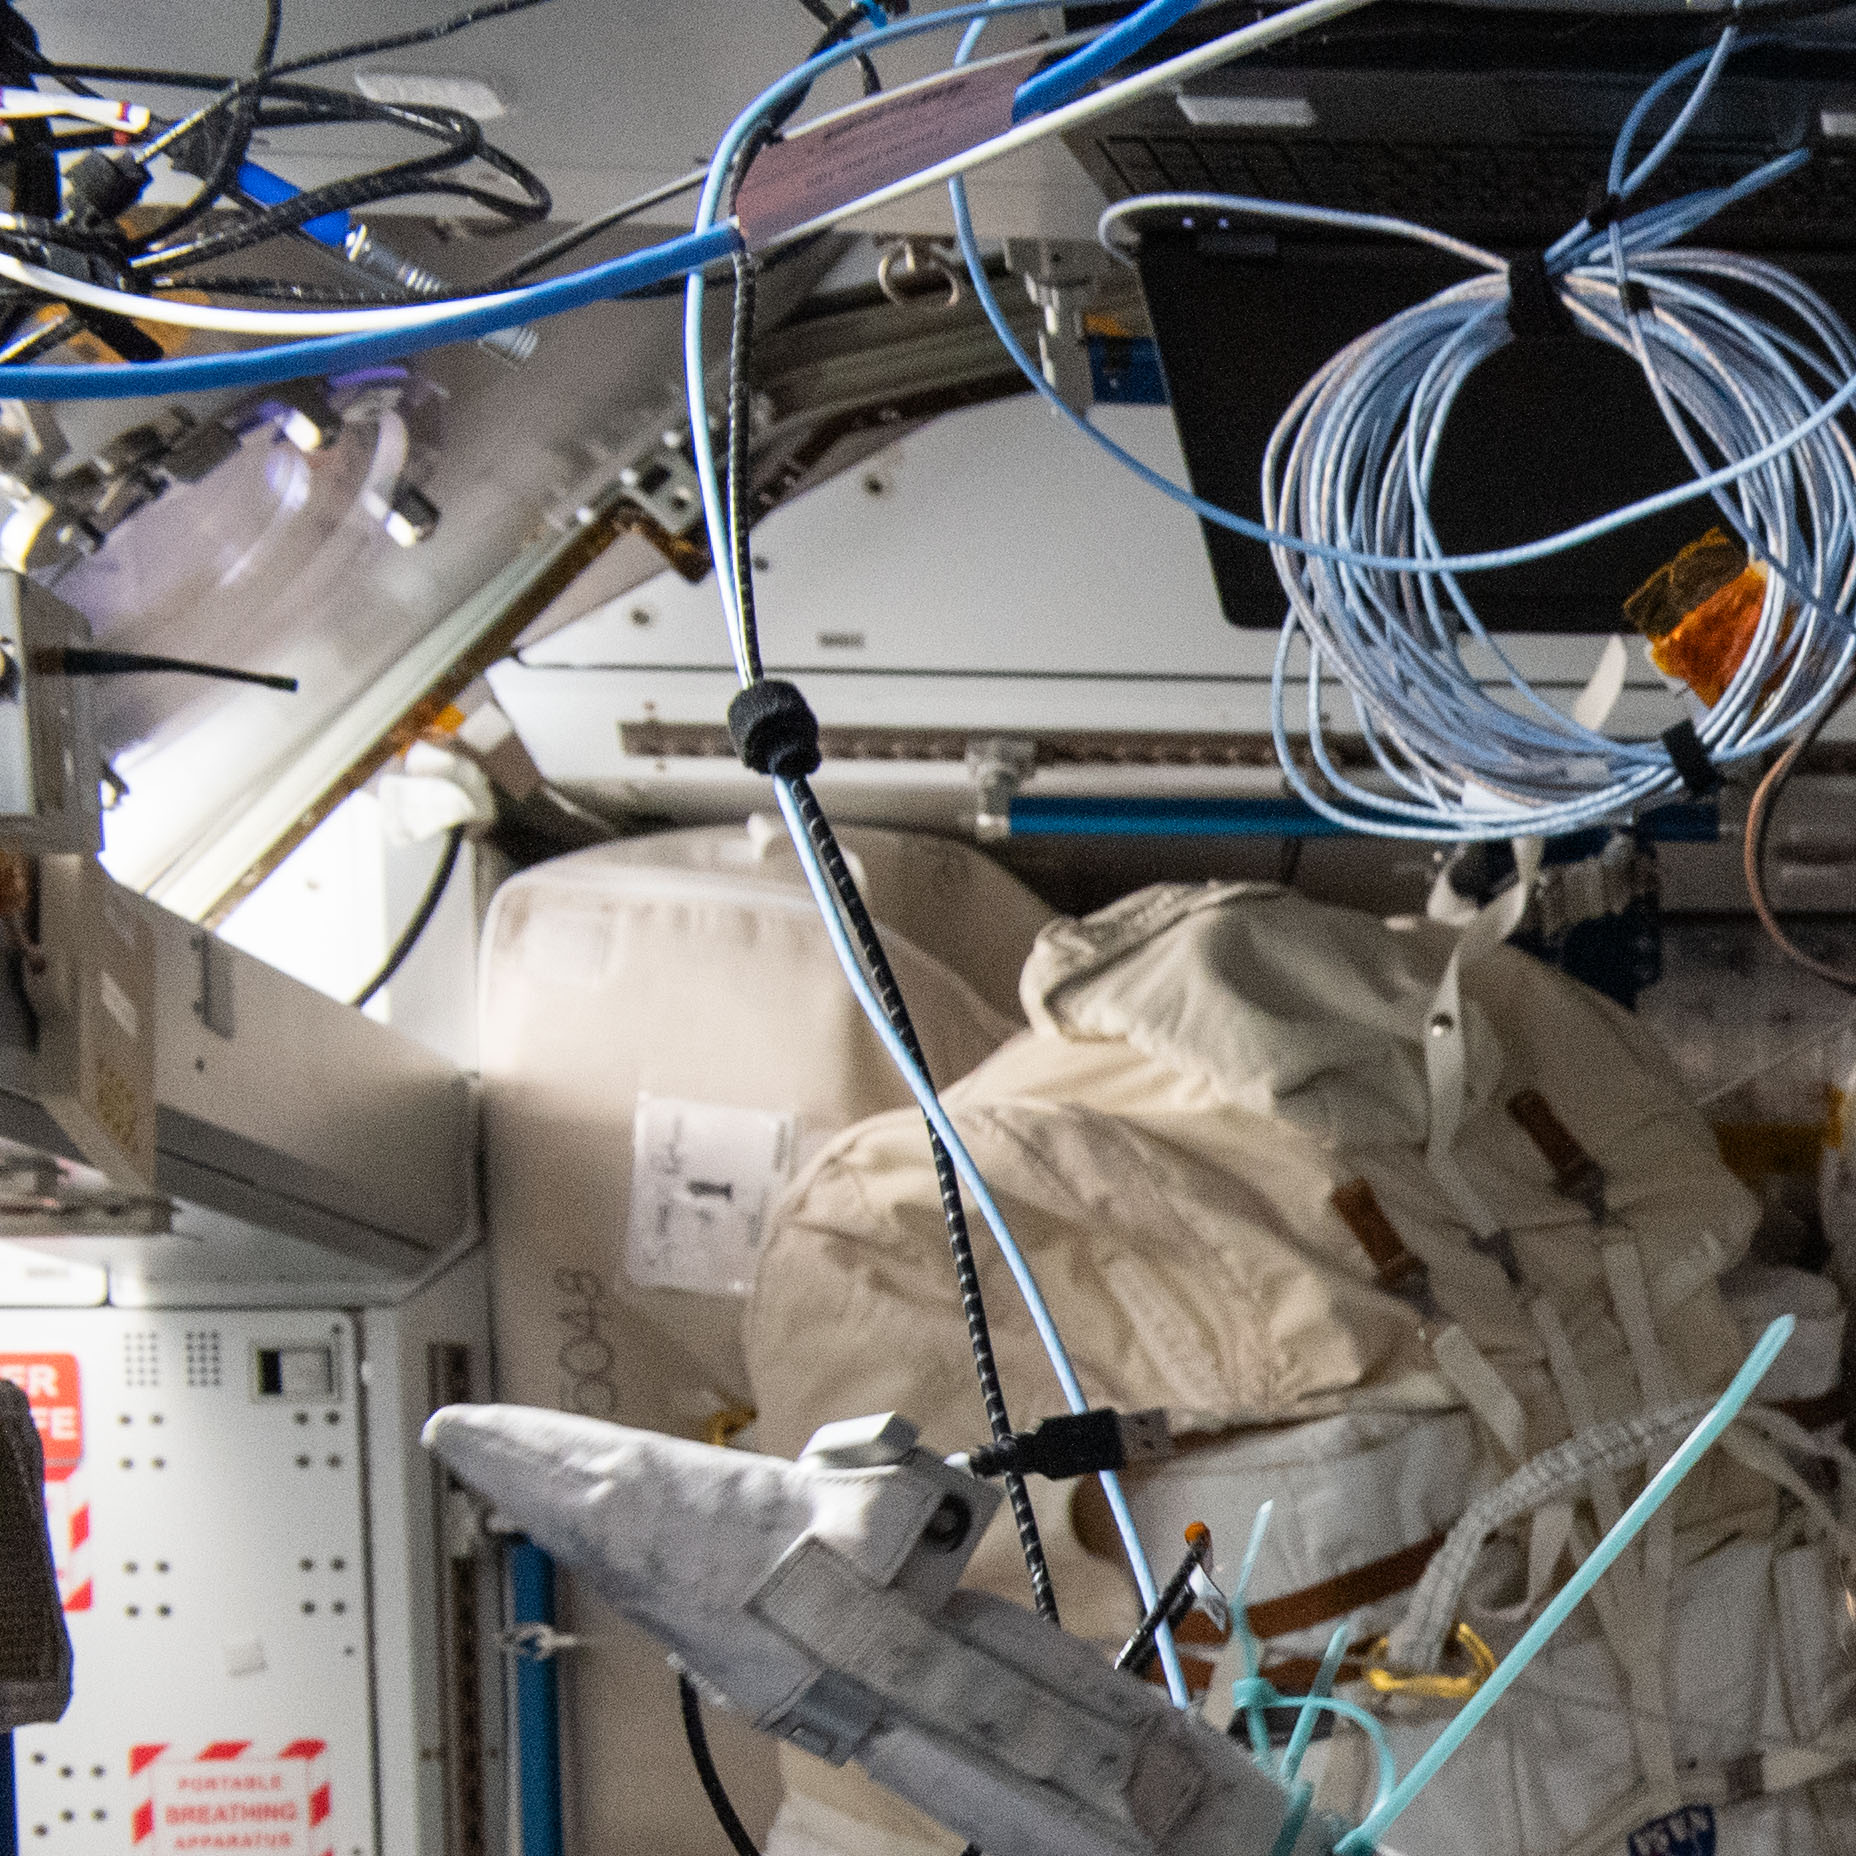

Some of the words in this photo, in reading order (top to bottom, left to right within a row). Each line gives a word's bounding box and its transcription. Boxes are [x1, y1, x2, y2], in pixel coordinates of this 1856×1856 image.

[177, 1775, 283, 1791] PORTABLE
[164, 1802, 298, 1826] BREATHING
[174, 1833, 293, 1850] APPARATUS
